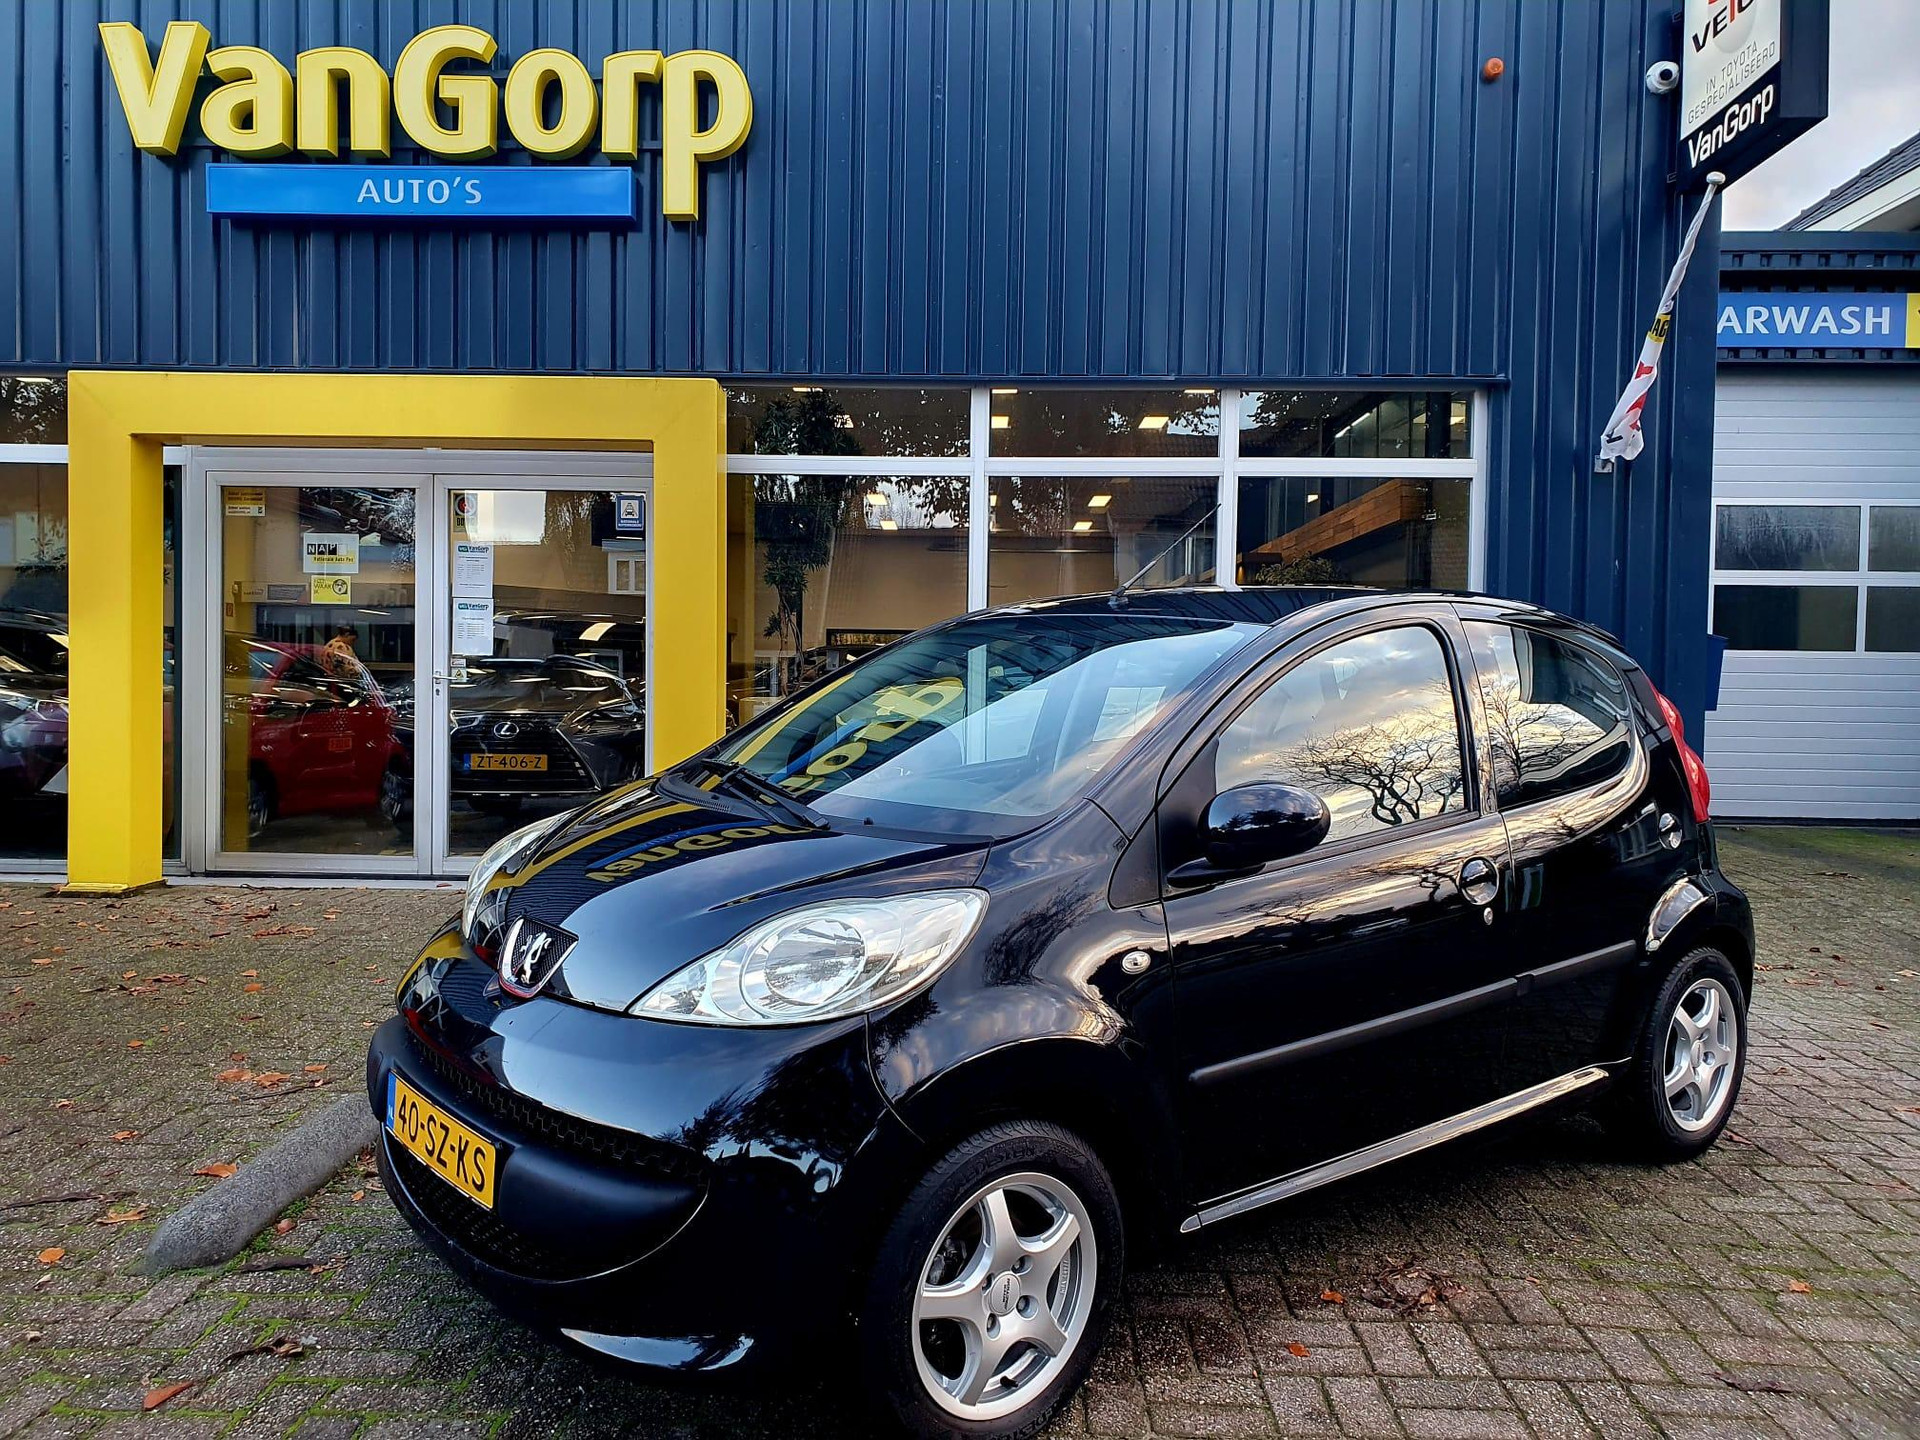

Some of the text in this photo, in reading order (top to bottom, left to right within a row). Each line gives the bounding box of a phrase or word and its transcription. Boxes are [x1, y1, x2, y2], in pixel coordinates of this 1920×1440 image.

[1688, 41, 1776, 124] GESPECIALISEERD
[1706, 41, 1758, 94] IN TOYOTA
[100, 21, 752, 221] VanGorp
[1688, 84, 1774, 169] VanGorp
[357, 178, 482, 205] AUTO'S
[1717, 306, 1890, 335] ARWASH
[308, 544, 337, 554] NAP
[476, 755, 543, 769] ZT-406-Z
[398, 1094, 486, 1193] 40-SZ-KS
